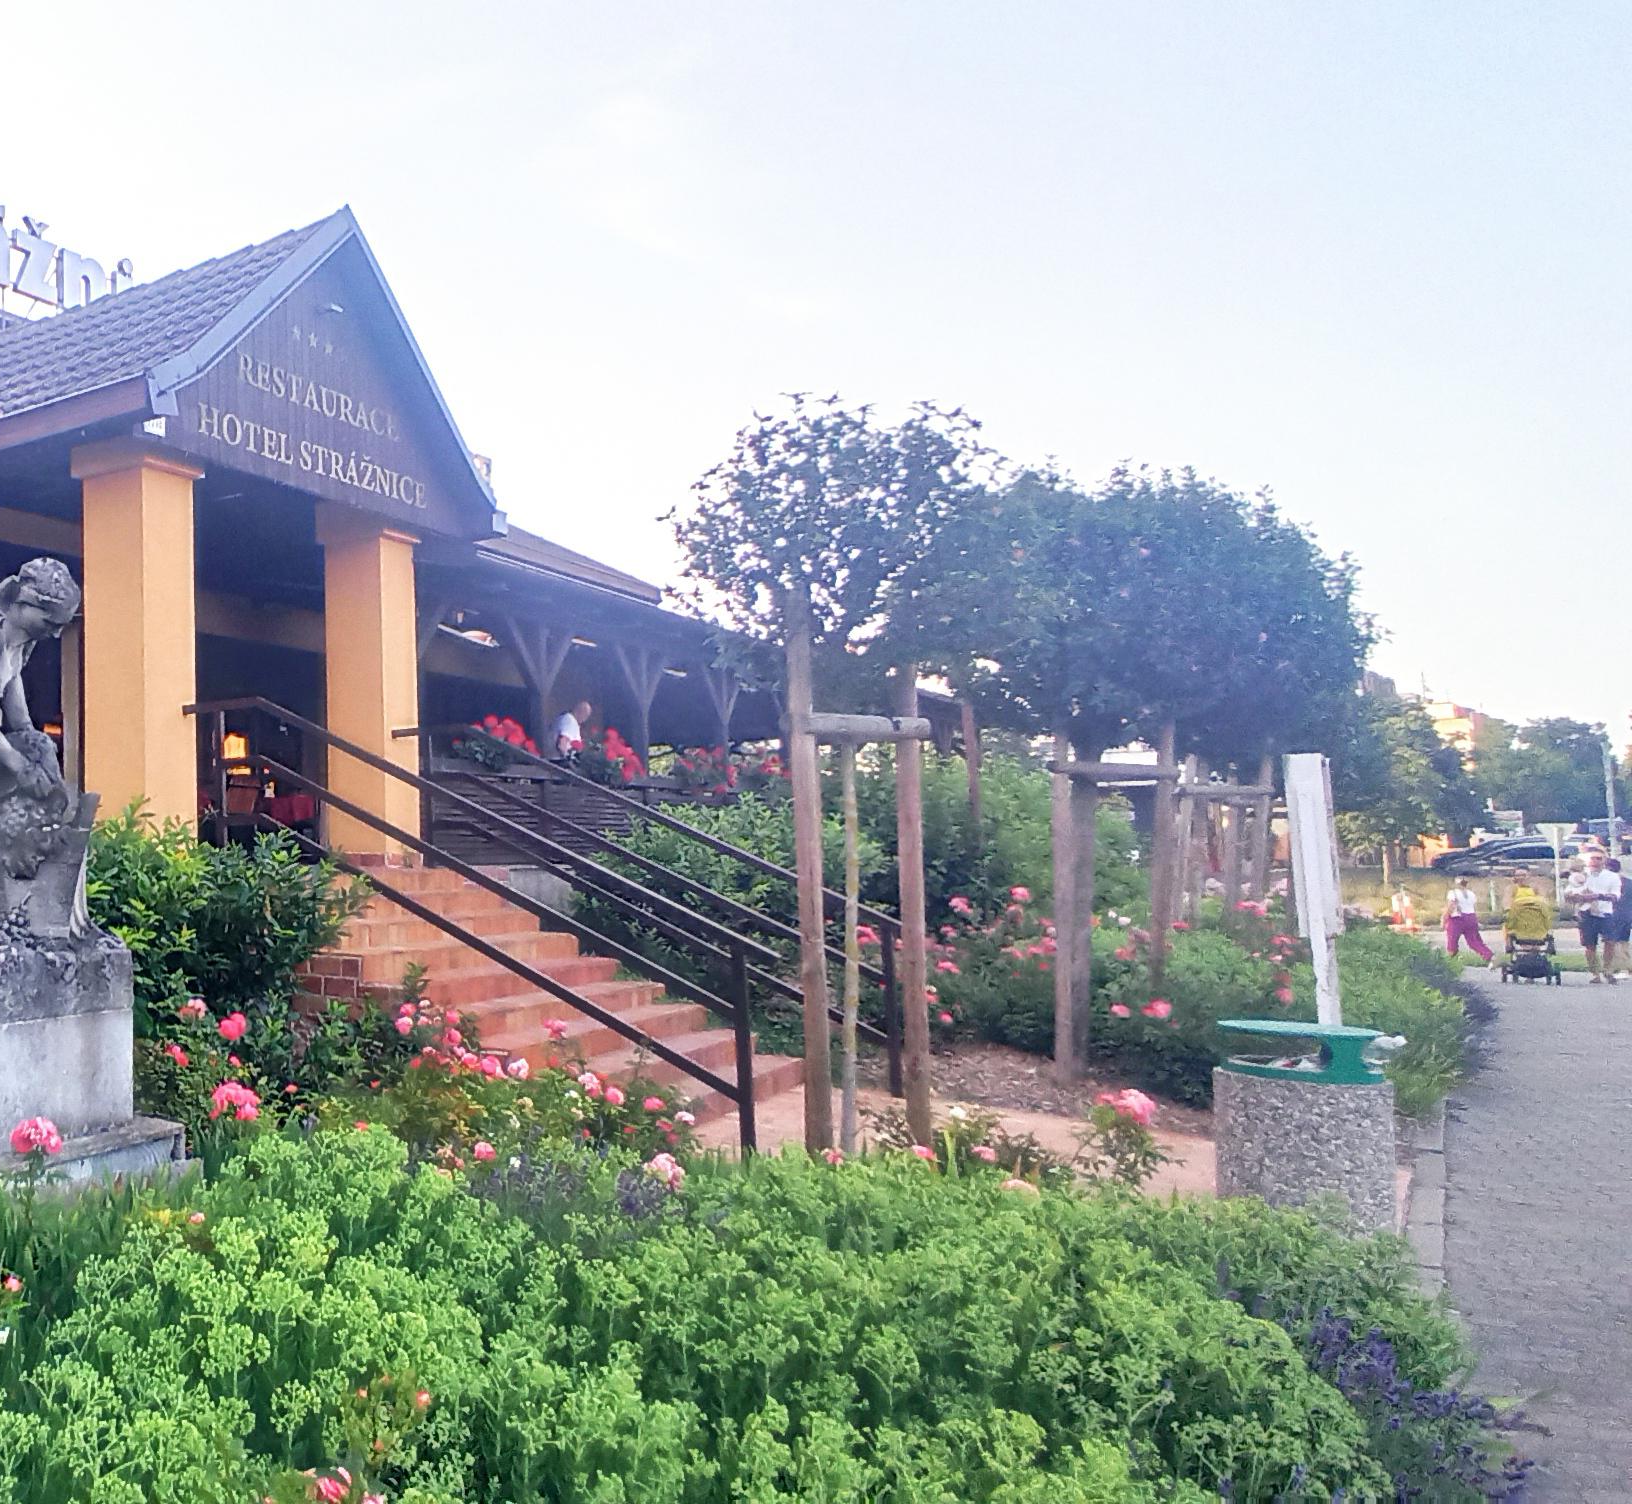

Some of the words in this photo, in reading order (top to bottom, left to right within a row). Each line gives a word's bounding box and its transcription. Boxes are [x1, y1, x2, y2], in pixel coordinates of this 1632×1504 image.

[239, 352, 400, 441] RESTAURACE
[198, 402, 293, 465] HOTEL
[299, 440, 427, 508] STRÁŽNICE
